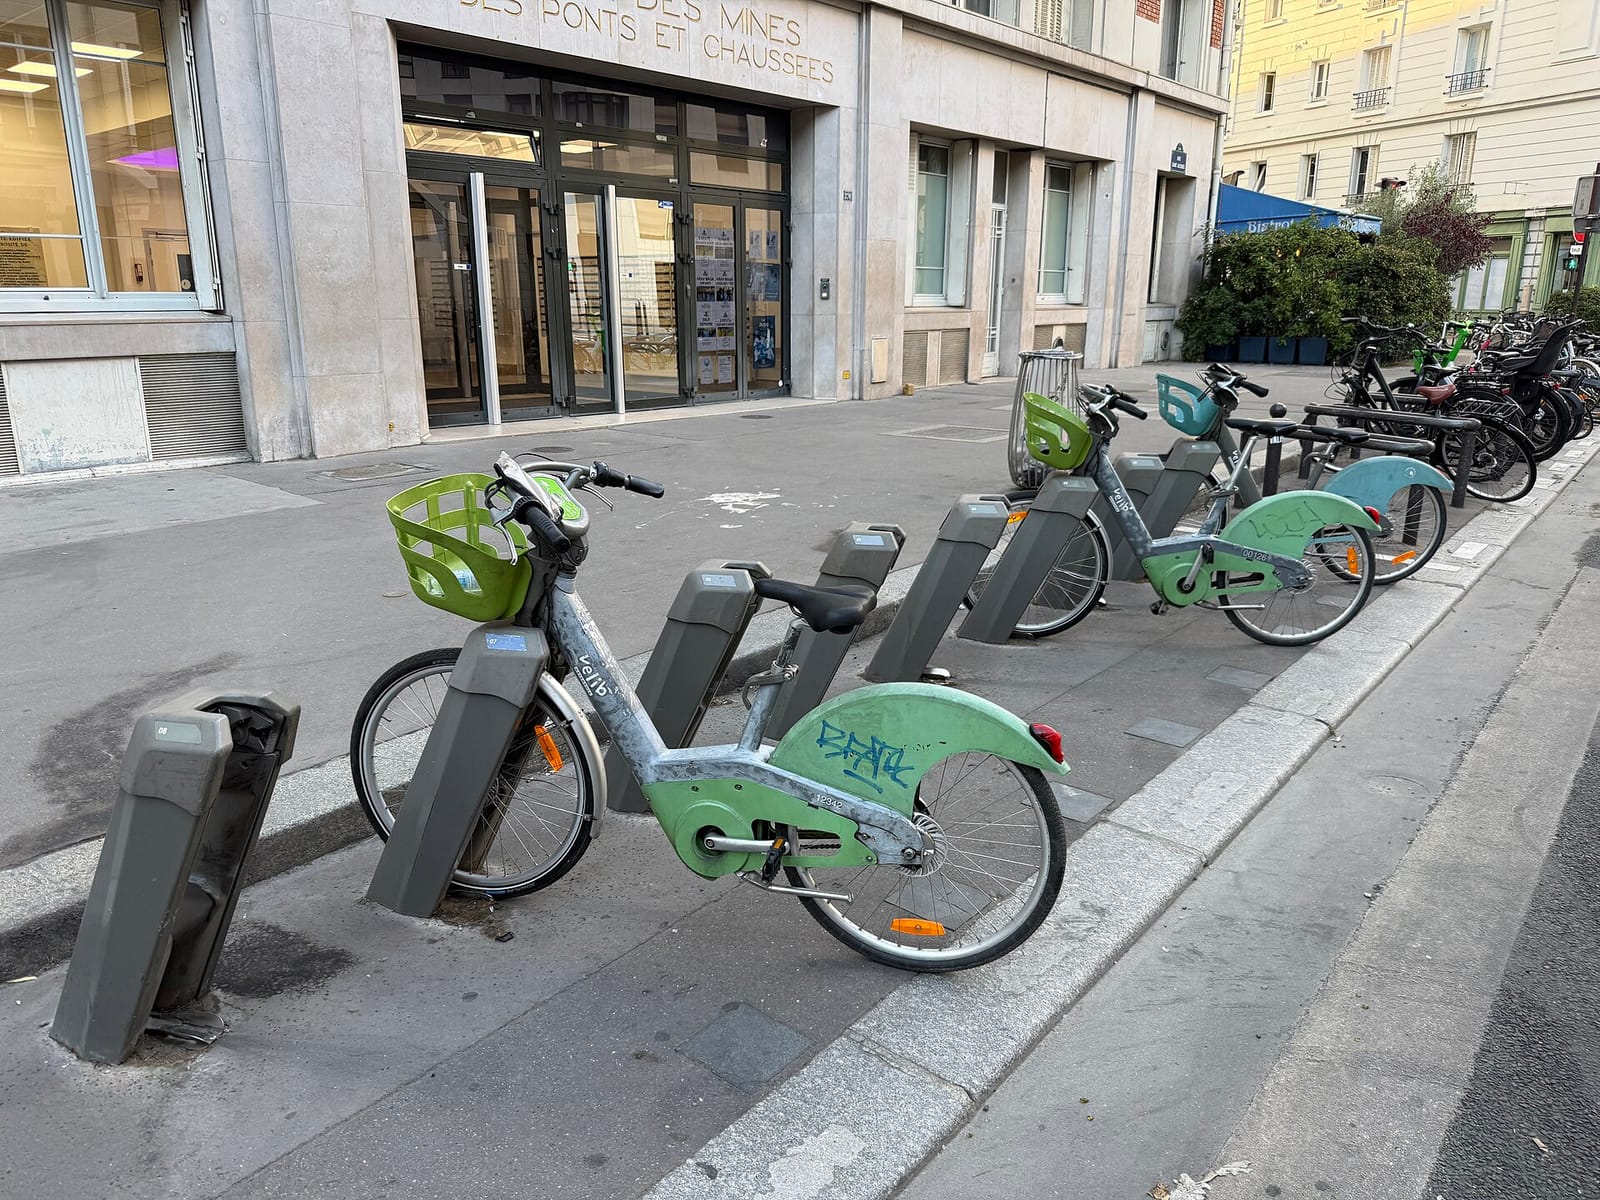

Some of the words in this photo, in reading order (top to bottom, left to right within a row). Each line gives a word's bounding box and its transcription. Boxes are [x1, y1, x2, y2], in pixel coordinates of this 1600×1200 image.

[543, 0, 637, 41] PONTS
[655, 22, 686, 52] ET
[703, 34, 834, 84] CHAUSSEES
[720, 3, 801, 47] MINES
[816, 794, 843, 810] 12342
